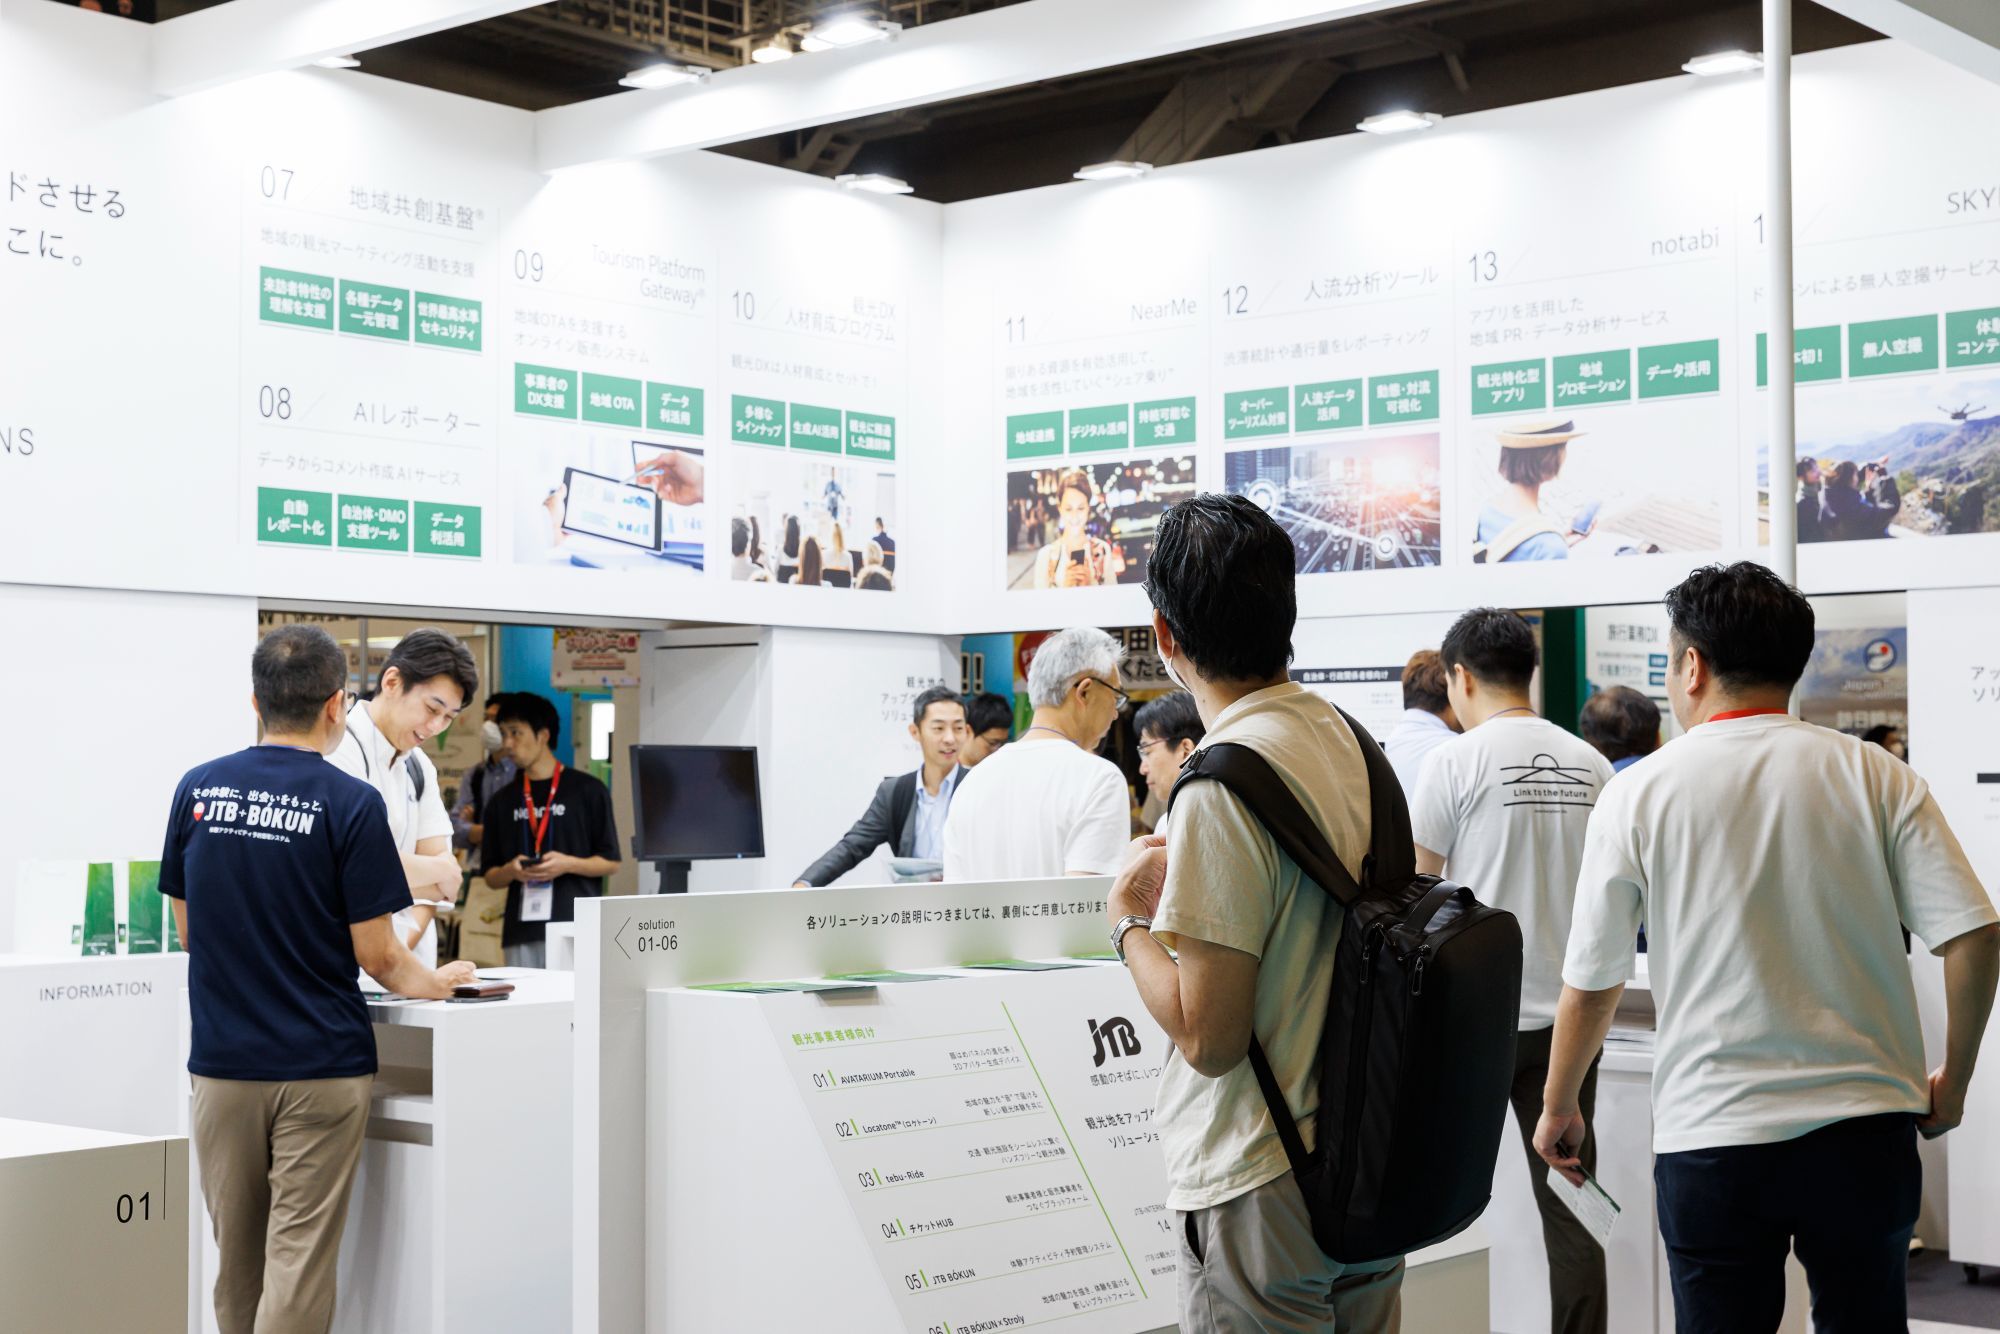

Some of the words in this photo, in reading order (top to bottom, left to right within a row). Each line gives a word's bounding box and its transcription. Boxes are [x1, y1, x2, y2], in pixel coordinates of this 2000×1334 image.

[261, 166, 295, 200] 07
[1948, 187, 2000, 214] SKY
[1753, 213, 1763, 244] 1
[1651, 227, 1720, 256] notabi
[515, 249, 543, 282] 09
[592, 243, 645, 272] Tourism
[649, 255, 705, 283] Platform
[1469, 251, 1498, 282] 13
[1304, 265, 1439, 302] 人流分析ツール
[732, 288, 755, 320] 10
[1130, 298, 1197, 321] NearMe
[1223, 285, 1248, 315] 12
[1470, 297, 1584, 324] アプリを活用した
[420, 321, 475, 341] セキュリティ
[1005, 315, 1025, 343] 11
[1646, 360, 1711, 381] データ活用
[1491, 388, 1525, 404] アプリ
[1557, 378, 1626, 397] プロモーション
[260, 385, 291, 420] 08
[660, 392, 690, 408] データ
[1240, 398, 1274, 413] オーバー
[1301, 389, 1356, 407] 人流データ
[353, 402, 481, 433] AIレポーター
[735, 420, 783, 438] ラインナップ
[267, 517, 325, 536] レポート化
[431, 512, 464, 528] データ
[1514, 789, 1531, 797] Link
[1543, 789, 1558, 797] the
[1560, 789, 1587, 798] future
[638, 919, 675, 931] solution
[638, 935, 678, 952] 01-06
[39, 982, 153, 1002] INFORMATION
[792, 1027, 875, 1046] 観光事業者様向け
[1088, 1016, 1142, 1068] JTB
[812, 1072, 829, 1088] 01
[841, 1071, 883, 1085] AVATARIUM
[884, 1068, 916, 1081] Portable
[836, 1122, 852, 1137] 02
[858, 1172, 875, 1188] 03
[885, 1169, 925, 1184] tebu-Ride
[117, 1192, 150, 1223] 01
[881, 1223, 898, 1238] 04
[909, 1218, 954, 1233] チケットHUB
[1158, 1219, 1172, 1232] 14
[905, 1274, 922, 1290] 05
[932, 1274, 947, 1285] JTB
[1003, 1314, 1025, 1327] Stroly
